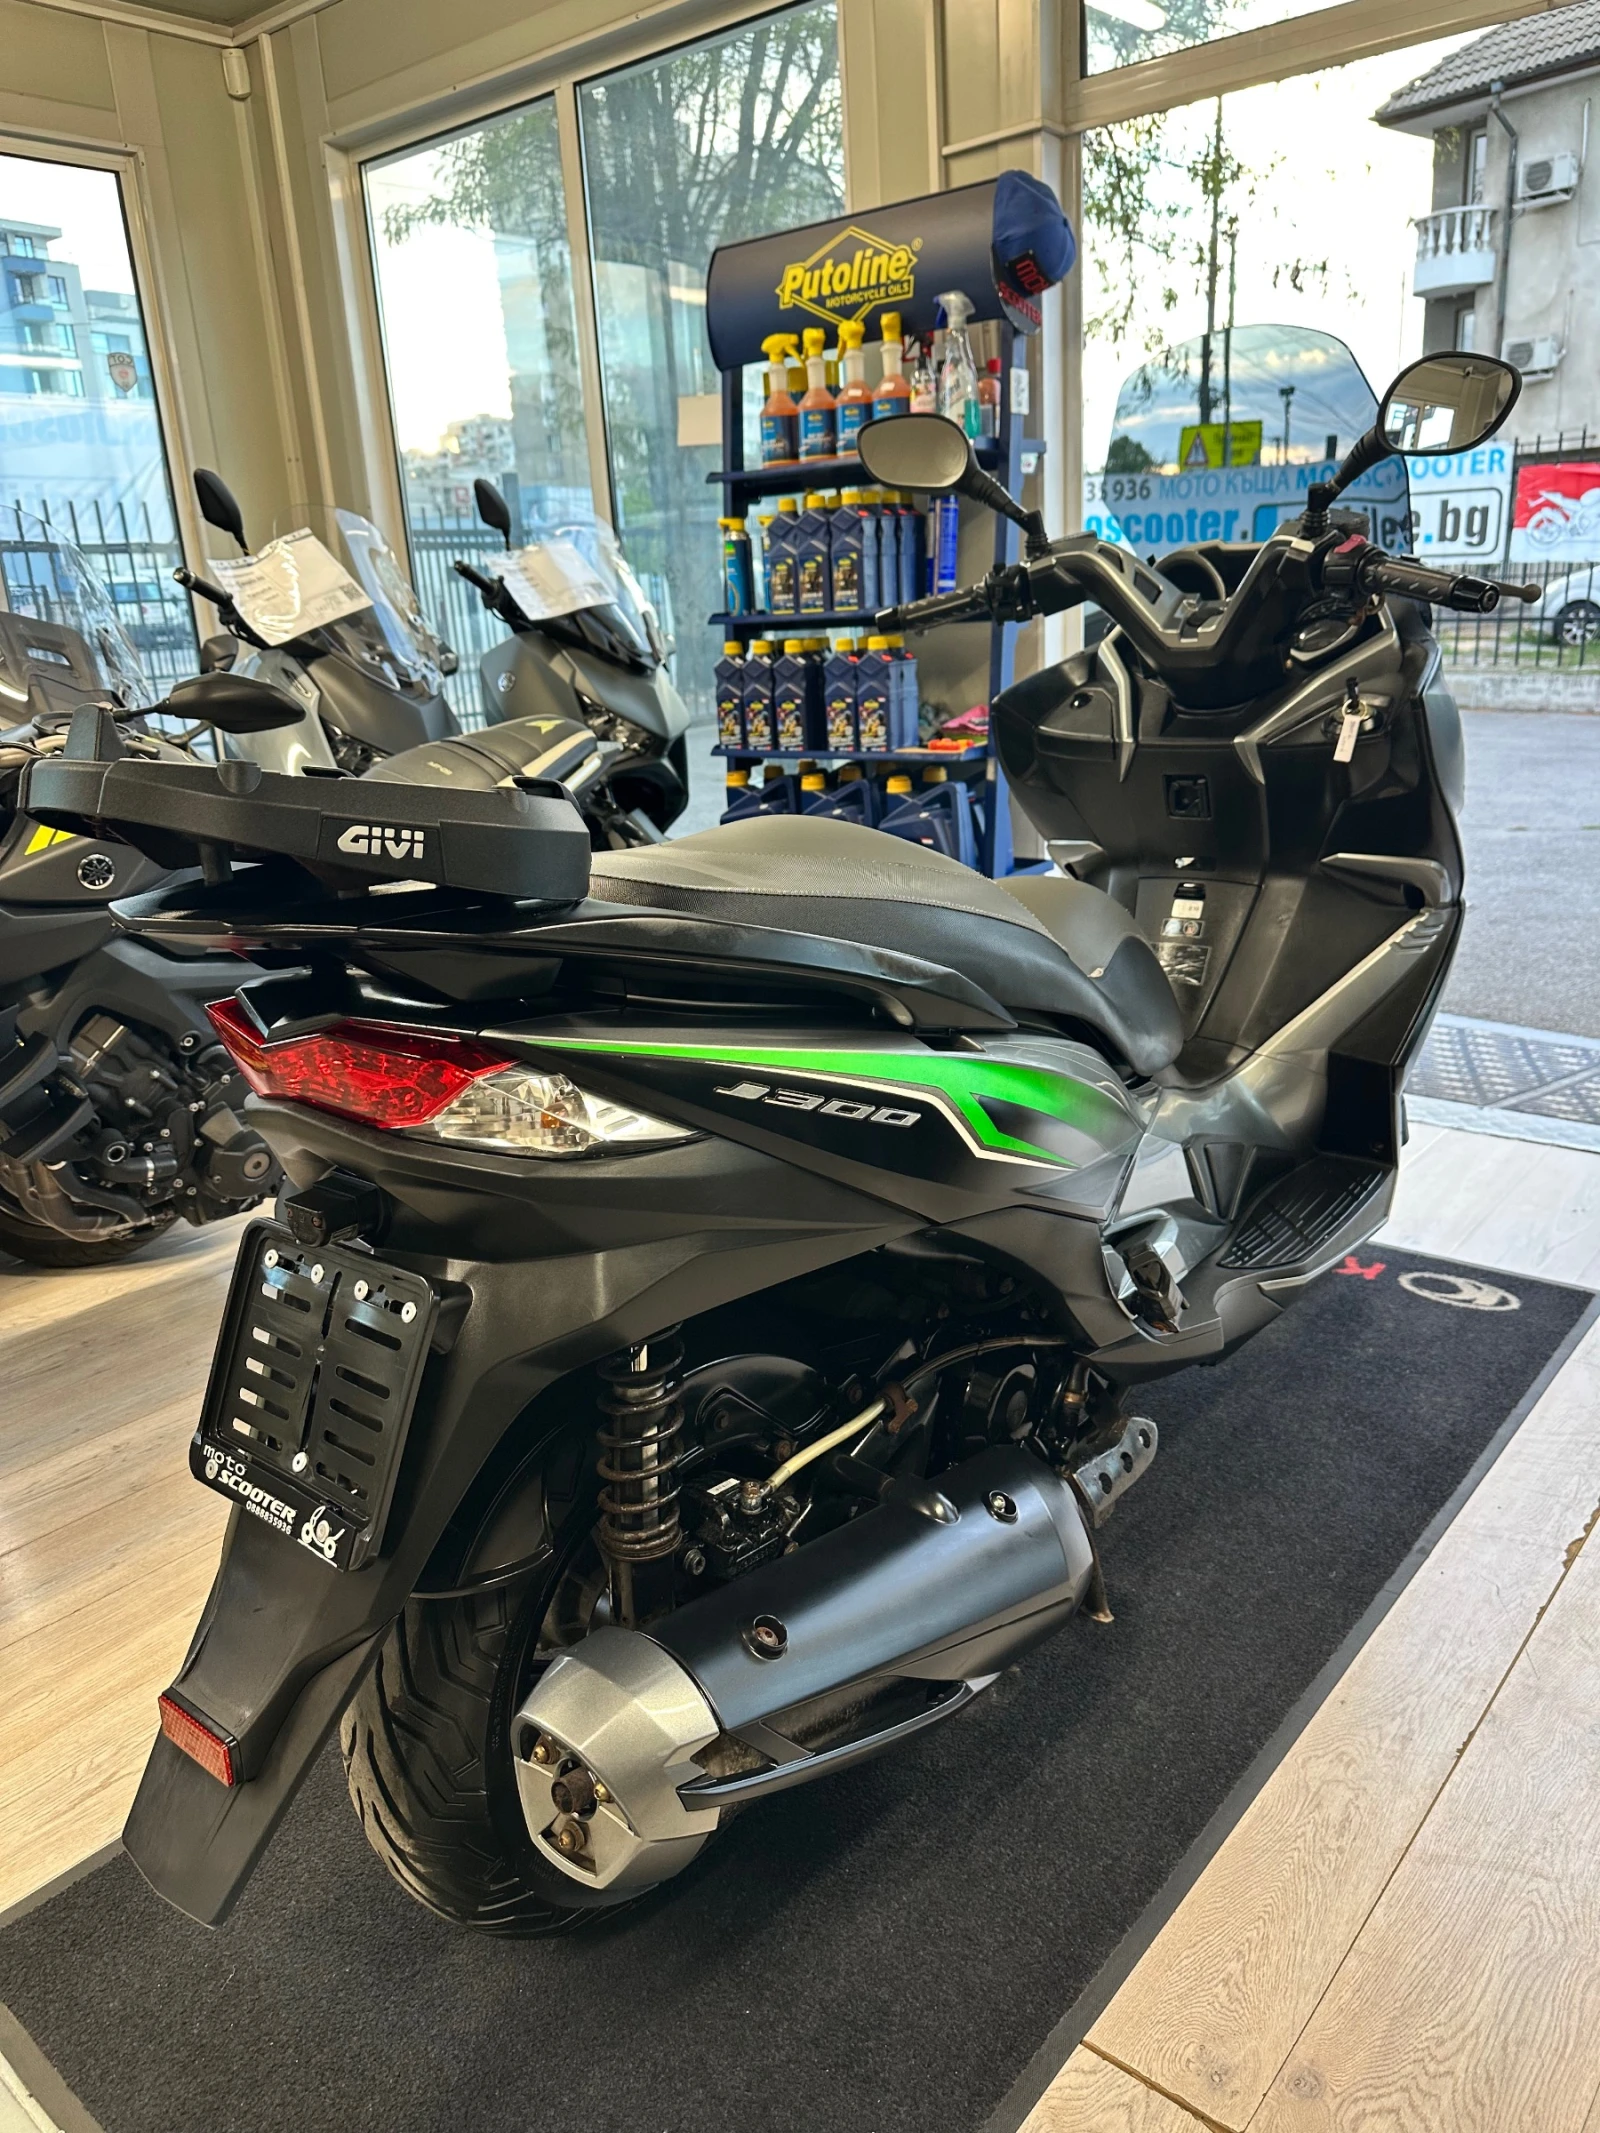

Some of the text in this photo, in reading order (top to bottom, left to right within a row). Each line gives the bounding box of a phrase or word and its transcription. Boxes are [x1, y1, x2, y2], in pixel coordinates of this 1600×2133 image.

[783, 248, 909, 304] Putoline
[825, 280, 910, 309] MOTORCYCLE OILS
[1112, 477, 1151, 501] 936
[1225, 465, 1291, 497] КЪЩА
[337, 825, 425, 860] GIVI
[713, 1081, 922, 1128] J300
[203, 1444, 246, 1476] moto
[217, 1469, 297, 1525] SCOOTER
[245, 1500, 293, 1535] 0888835936
